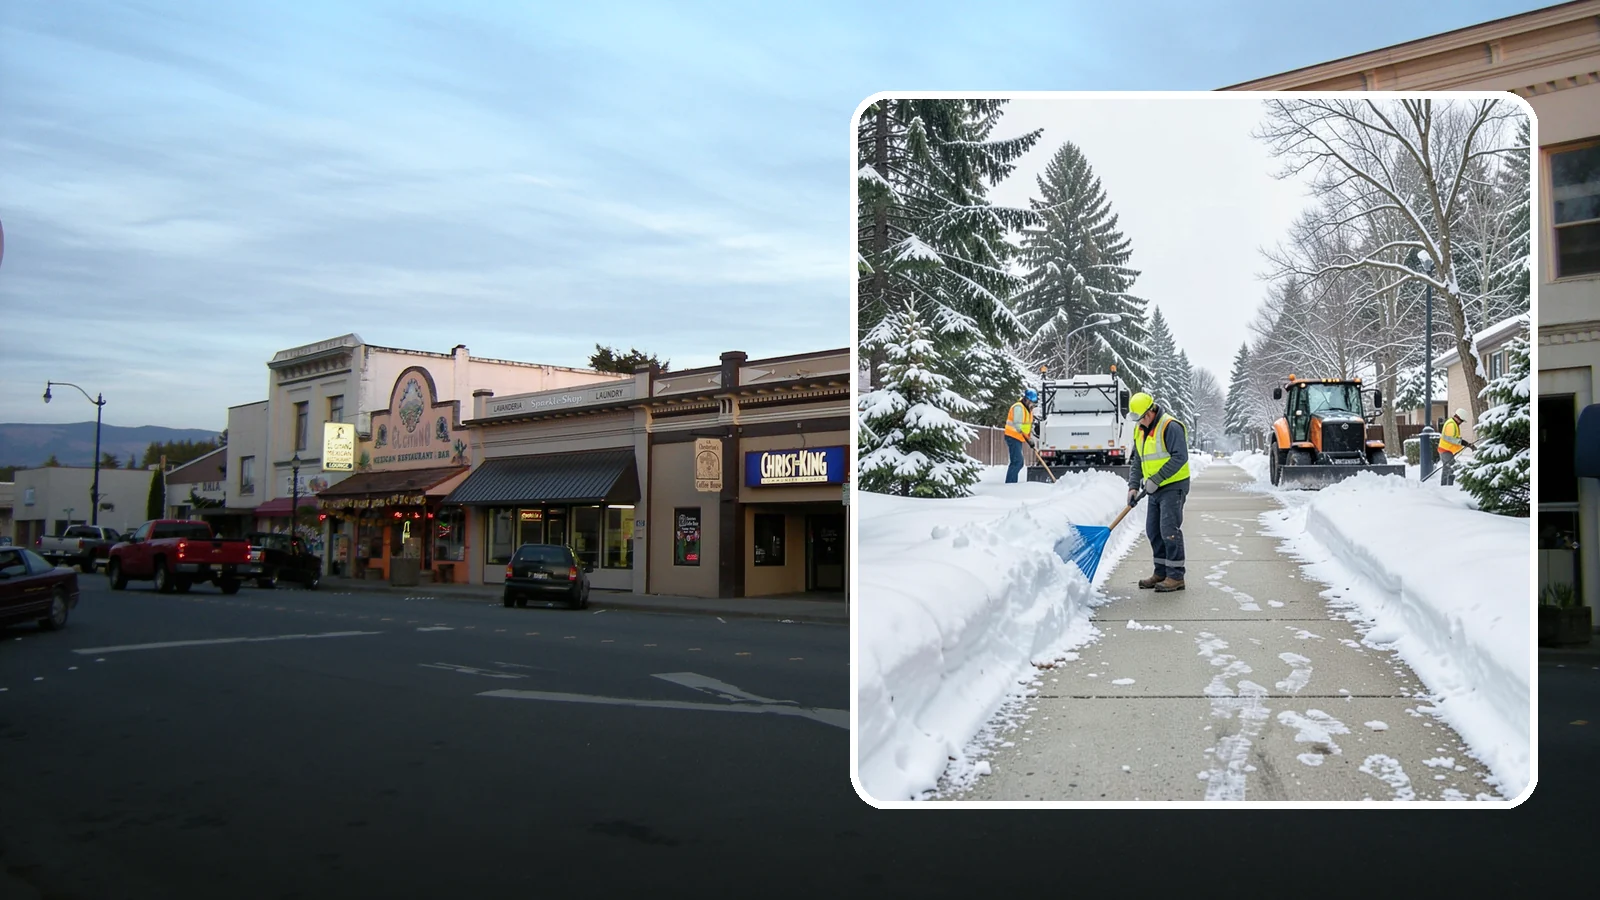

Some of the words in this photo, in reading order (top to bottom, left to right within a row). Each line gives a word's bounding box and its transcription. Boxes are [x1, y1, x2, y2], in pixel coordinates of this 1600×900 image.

[531, 397, 561, 408] Sparkle
[562, 394, 583, 404] Shop
[595, 389, 624, 400] LAUNDRY
[493, 401, 523, 413] LAVANDERIA
[373, 455, 396, 464] MEXICAN
[397, 451, 433, 462] RESTAURANT
[438, 450, 450, 459] BAR
[761, 452, 797, 478] CHRIST
[799, 450, 827, 477] KING
